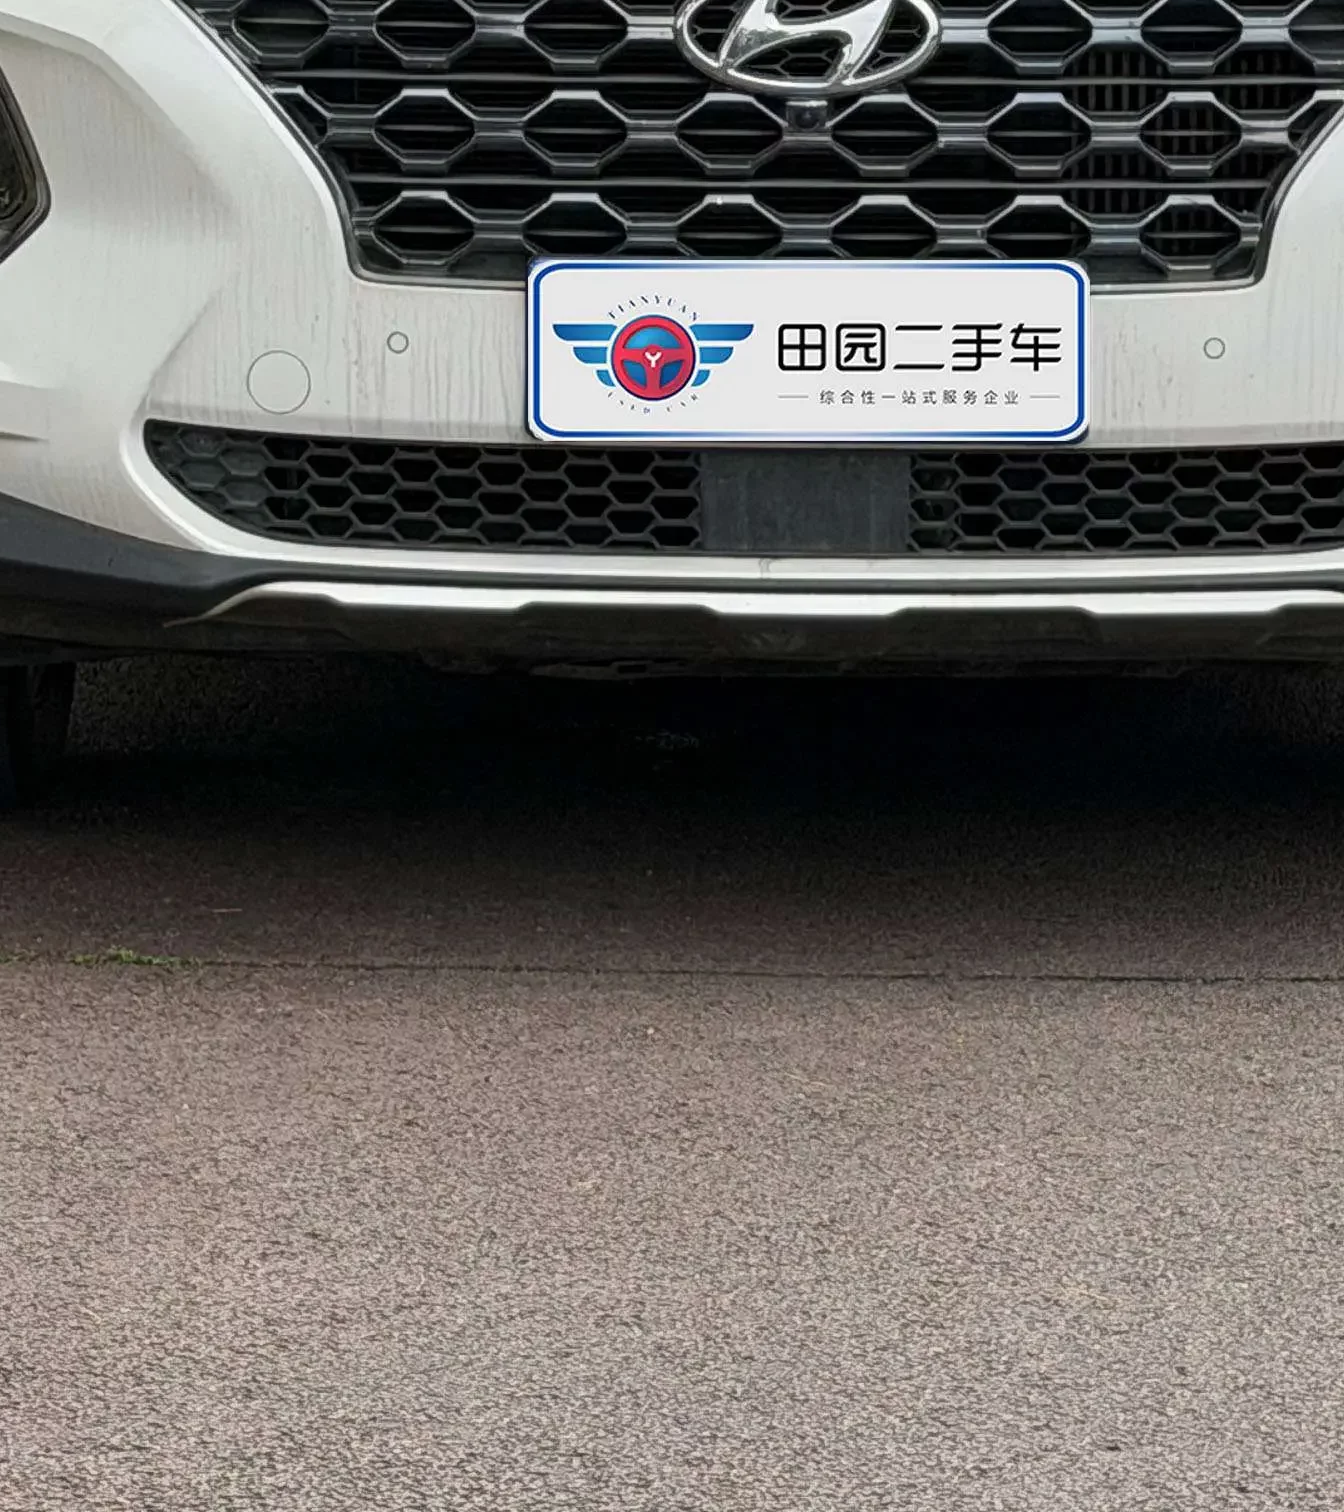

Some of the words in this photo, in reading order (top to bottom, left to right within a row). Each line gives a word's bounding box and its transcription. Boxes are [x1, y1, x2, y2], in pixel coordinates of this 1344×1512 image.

[777, 322, 1062, 372] 田园二手车
[819, 389, 1019, 406] 综合性一站式服务企业
